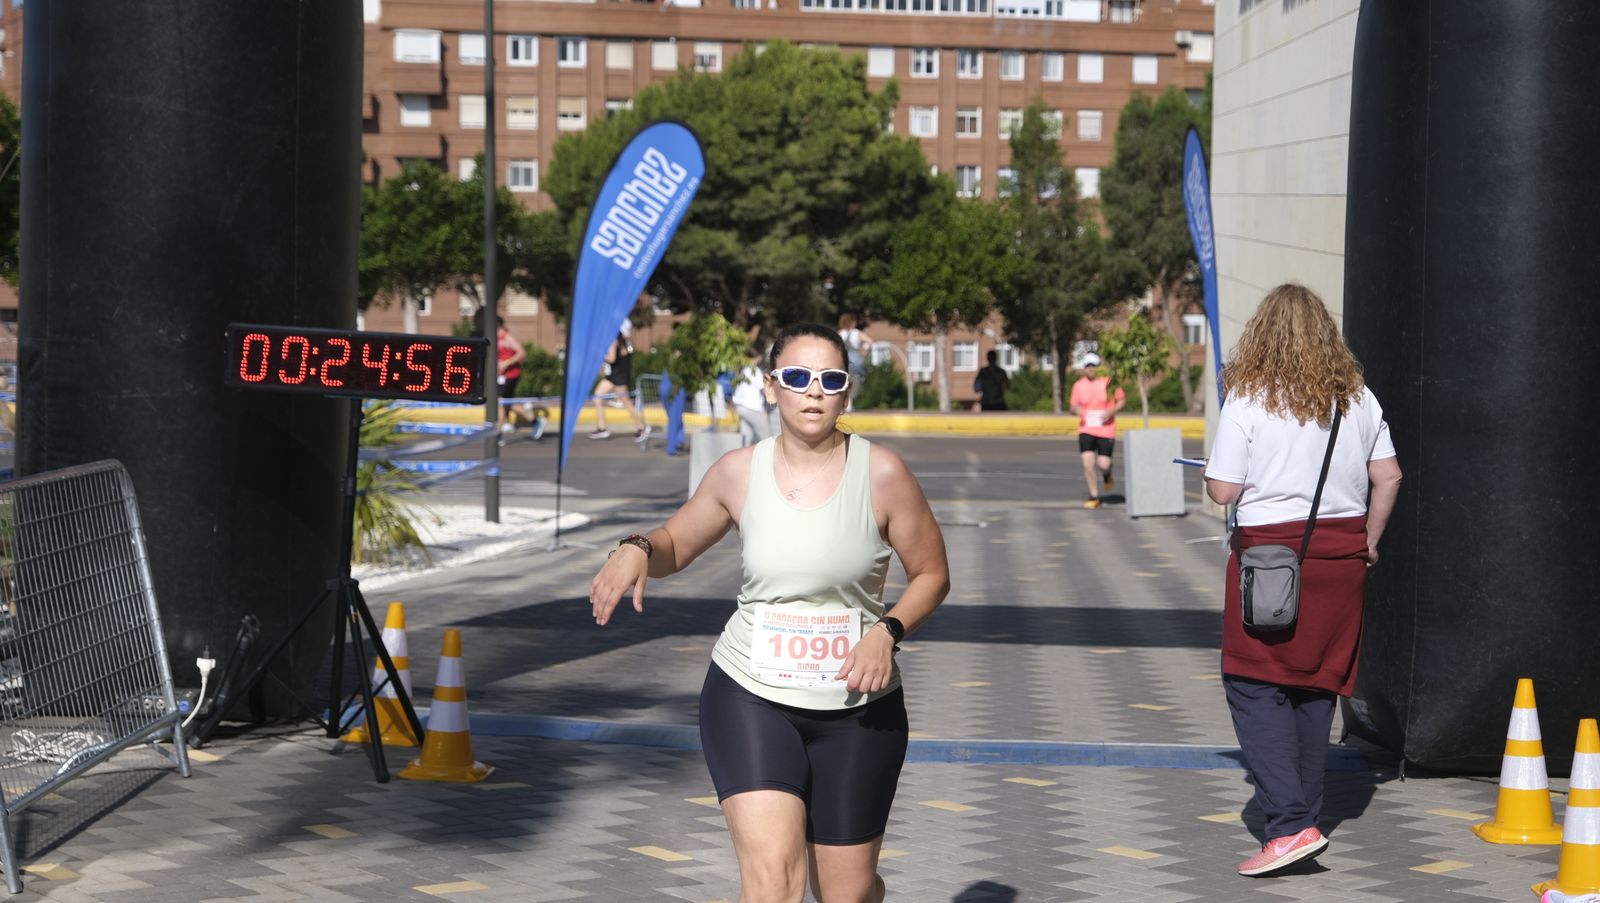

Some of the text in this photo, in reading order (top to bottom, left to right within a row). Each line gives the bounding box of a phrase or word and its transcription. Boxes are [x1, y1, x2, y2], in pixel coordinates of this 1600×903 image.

[239, 333, 472, 395] 00:24:56
[811, 616, 825, 624] SIN
[827, 614, 850, 624] HUMO
[768, 634, 850, 660] 1090
